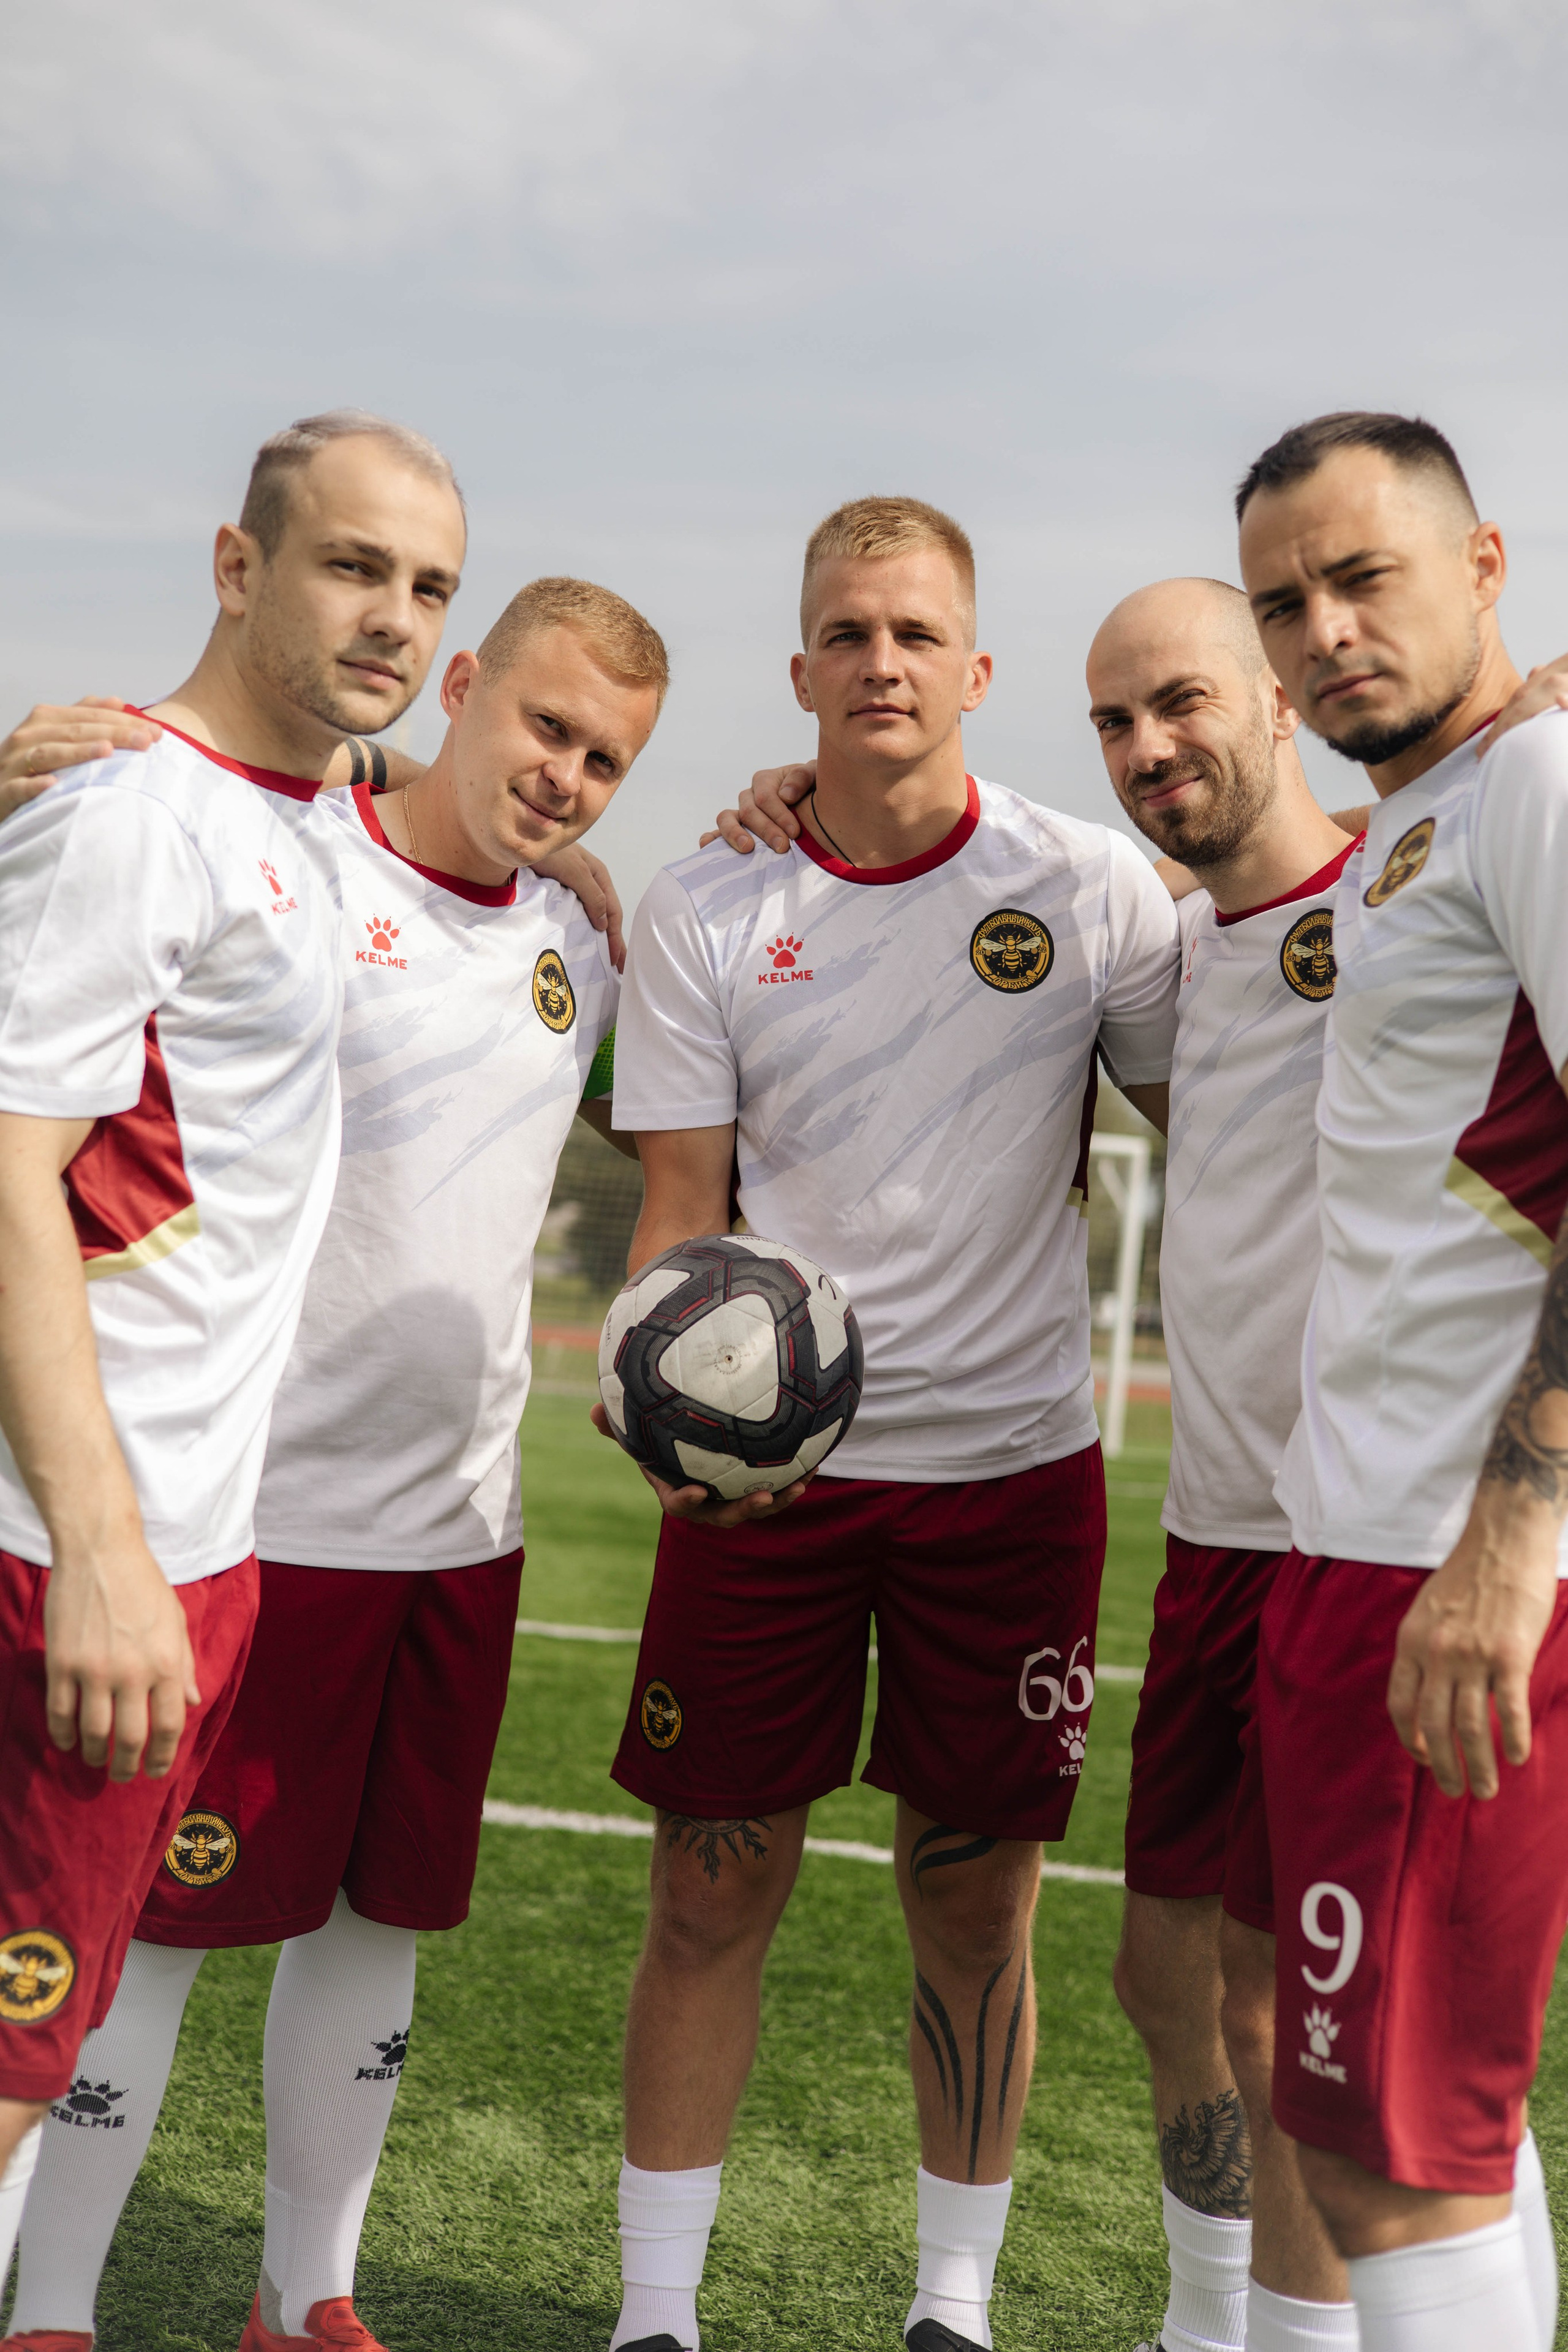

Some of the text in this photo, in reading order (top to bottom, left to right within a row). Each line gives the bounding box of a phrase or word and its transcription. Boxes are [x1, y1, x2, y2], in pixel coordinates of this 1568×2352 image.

[271, 897, 298, 916] KELME
[978, 913, 1044, 938] ФУТБОЛЬНЫЙ КЛУБ
[355, 951, 407, 970] KELME
[758, 970, 814, 985] KELME
[992, 975, 1038, 989] ОРБИТА
[1303, 985, 1335, 997] ОРБИТ
[1018, 1635, 1095, 1721] 66
[1059, 1763, 1082, 1777] KEL
[1300, 1880, 1364, 1995] 9
[354, 2060, 405, 2081] KELM
[1298, 2051, 1348, 2085] KELME
